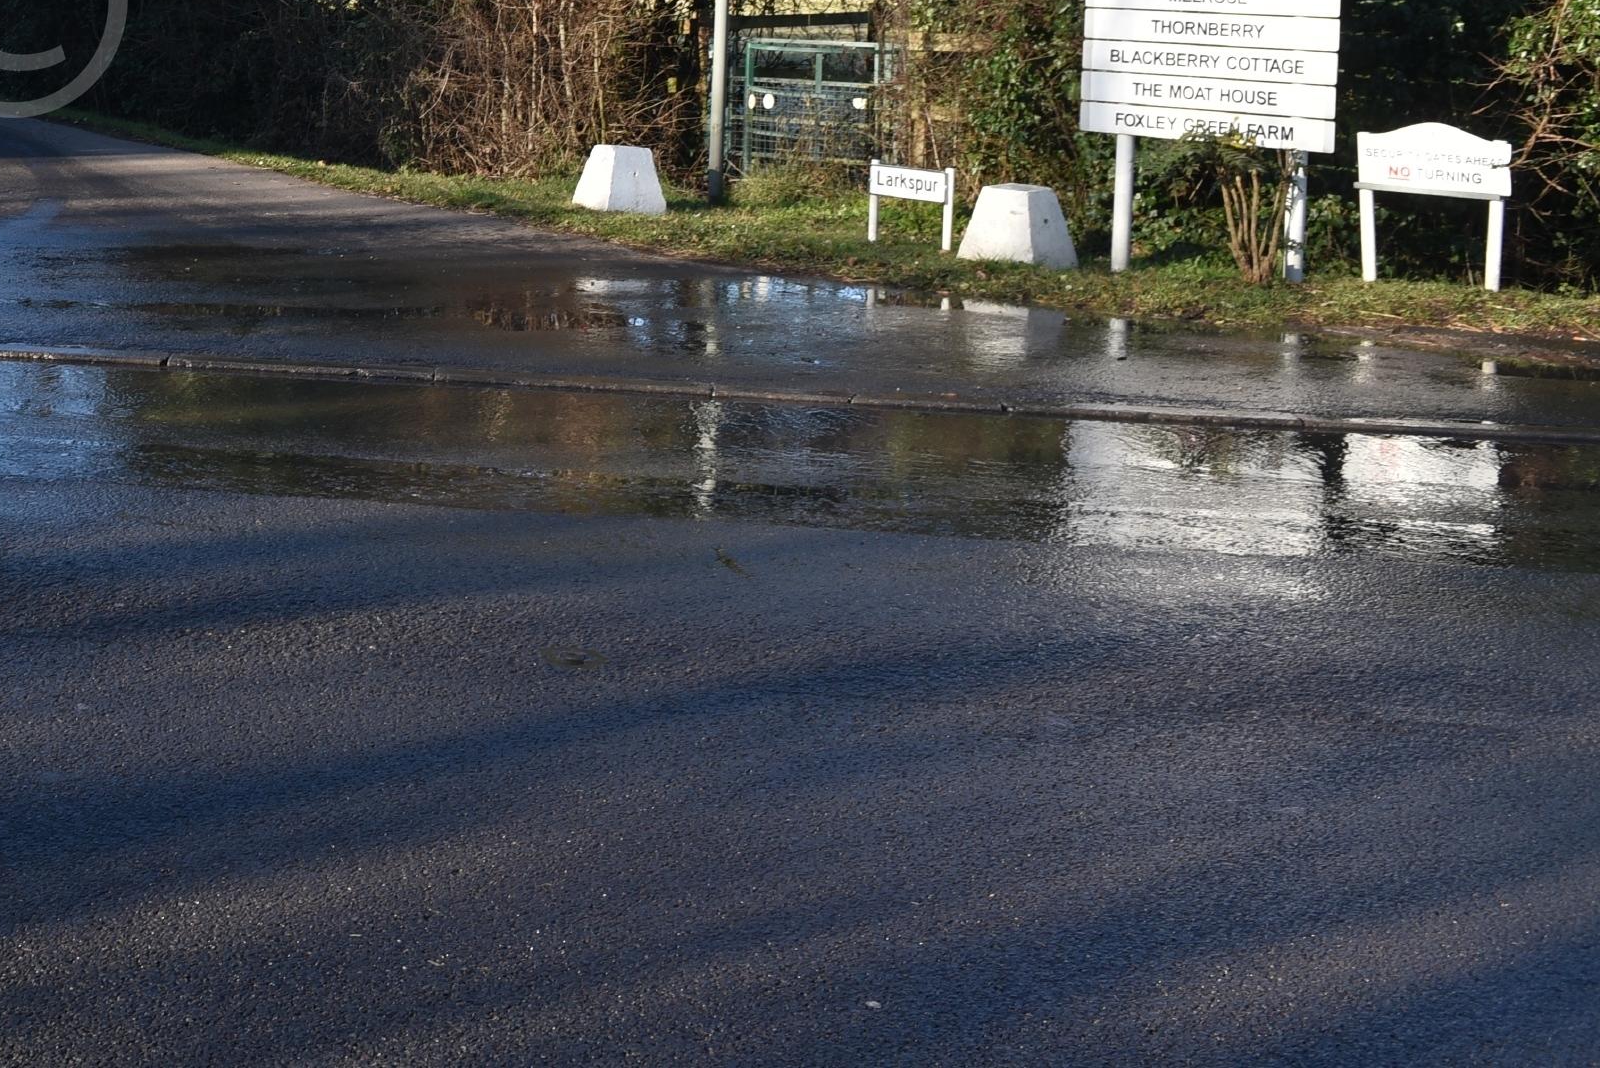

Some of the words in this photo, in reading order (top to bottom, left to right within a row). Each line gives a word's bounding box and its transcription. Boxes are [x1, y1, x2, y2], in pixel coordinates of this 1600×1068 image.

[1151, 20, 1265, 39] THORNBERRY
[1110, 49, 1221, 70] BLACKBERRY
[1227, 56, 1305, 75] COTTAGE
[1133, 82, 1163, 98] THE
[1169, 85, 1213, 101] MOAT
[1220, 89, 1278, 106] HOUSE
[1115, 112, 1177, 130] FOXLEY
[1184, 118, 1240, 135] GREEN
[1247, 123, 1294, 141] FARM
[1425, 151, 1462, 164] ATES
[877, 171, 939, 194] Larkspur
[1388, 165, 1411, 177] NO
[1416, 168, 1483, 184] TURNING
